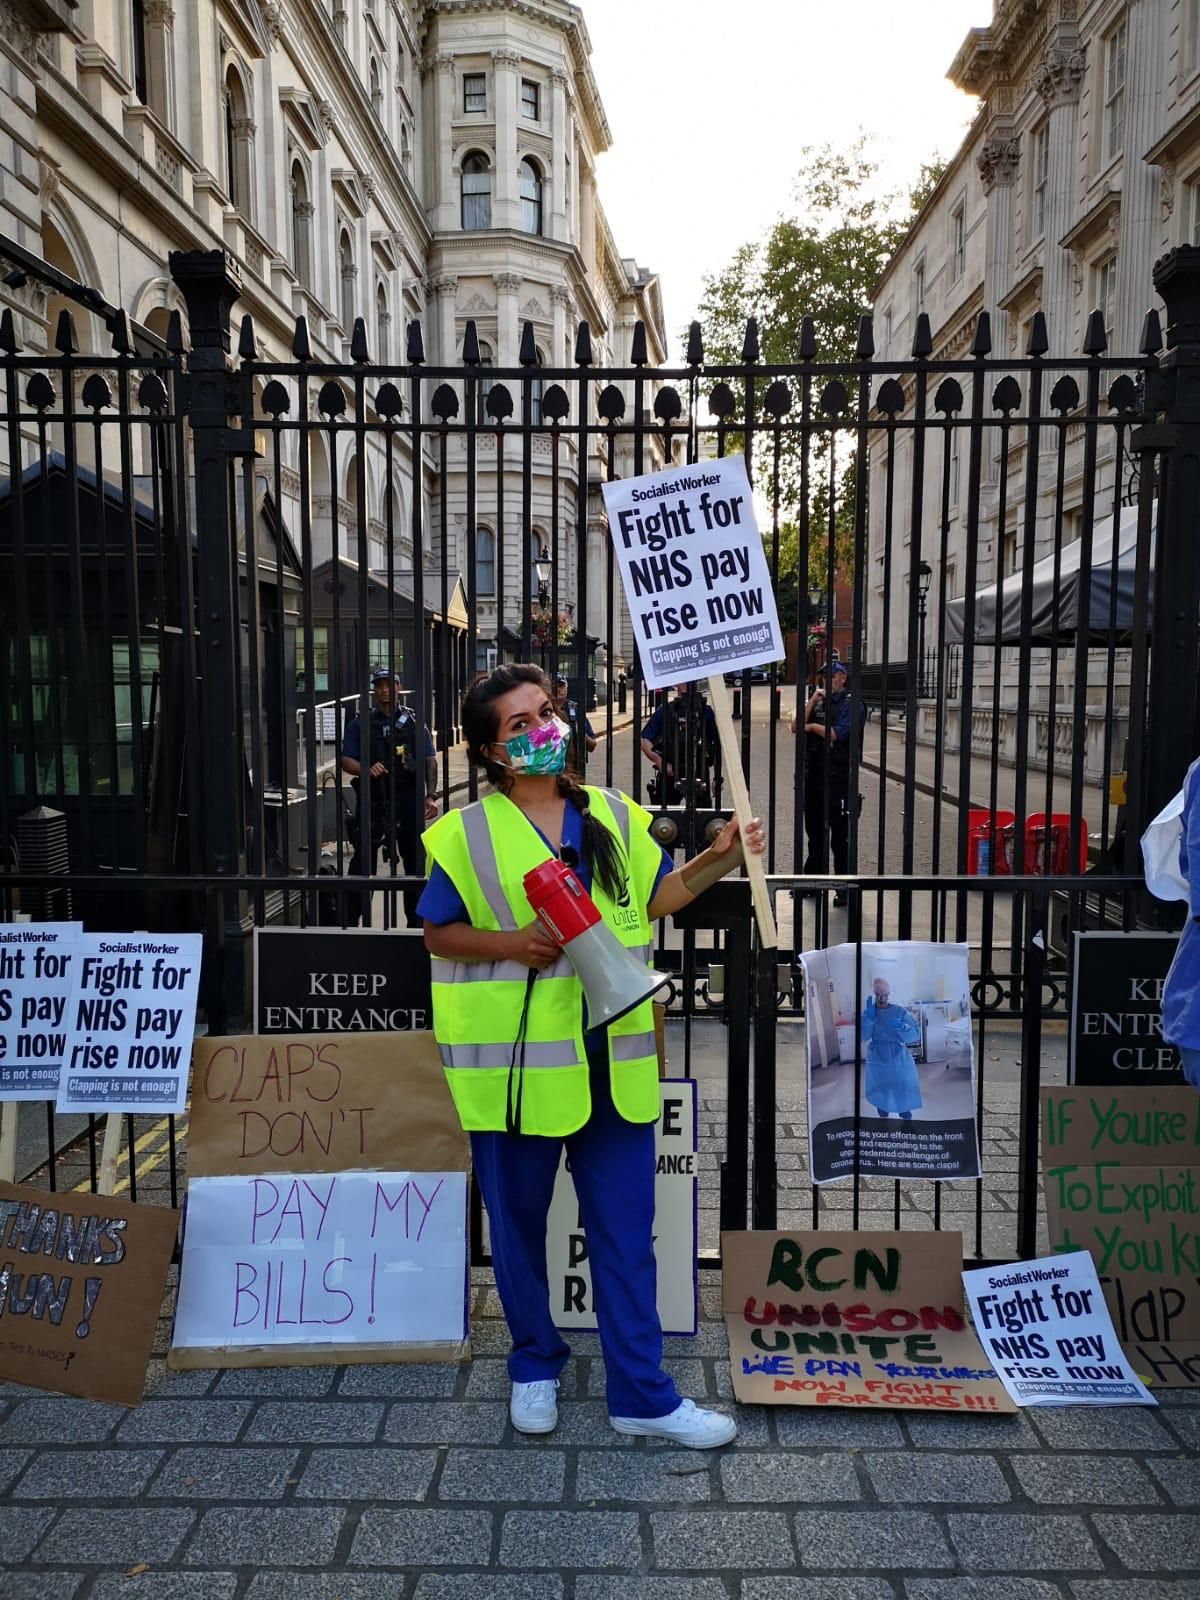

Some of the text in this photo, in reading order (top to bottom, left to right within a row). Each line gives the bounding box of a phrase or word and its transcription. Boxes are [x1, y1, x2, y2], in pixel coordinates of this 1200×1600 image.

[618, 492, 744, 552] Fight for
[628, 546, 750, 597] NHS pay
[640, 588, 764, 640] rise now
[652, 643, 699, 664] Clapping
[700, 640, 710, 653] is
[712, 634, 732, 650] not
[733, 625, 770, 646] enough
[612, 910, 638, 926] unite
[33, 947, 72, 978] for
[80, 957, 192, 996] Fight for
[308, 973, 387, 996] KEEP
[1128, 978, 1165, 1000] KE
[22, 996, 66, 1028] pay
[76, 999, 183, 1040] NHS pay
[264, 1006, 428, 1031] ENTRANCE
[1082, 1012, 1164, 1036] ENTR
[17, 1034, 66, 1058] now
[70, 1036, 182, 1070] rise now
[1112, 1048, 1183, 1070] CLE
[2, 1068, 61, 1080] is not enoug
[69, 1078, 109, 1094] Clapping
[111, 1080, 120, 1091] is
[122, 1080, 138, 1092] not
[142, 1080, 176, 1094] enough
[238, 1107, 374, 1158] DON'T
[826, 1133, 834, 1141] To
[836, 1130, 870, 1139] recogise
[872, 1131, 889, 1139] your
[890, 1130, 916, 1140] efforts
[1047, 1097, 1077, 1145] IF
[840, 1149, 896, 1158] unpcedented
[898, 1151, 940, 1161] challenges
[875, 1140, 918, 1151] responding
[830, 1160, 876, 1169] coronarus..
[937, 1161, 959, 1170] claps!
[1048, 1164, 1092, 1212] To
[248, 1176, 444, 1244] PAY MY
[1094, 1225, 1164, 1274] You
[767, 1238, 901, 1292] RCN
[744, 1296, 967, 1332] UNISON
[976, 1284, 1092, 1333] Fight for
[750, 1328, 942, 1364] UNITE
[989, 1333, 1106, 1363] NHS pay
[1003, 1362, 1124, 1380] rise now
[774, 1380, 965, 1396] NOW FIGHT
[816, 1392, 878, 1405] FOR
[1016, 1382, 1063, 1392] Clapping
[1076, 1384, 1095, 1392] not
[1096, 1384, 1136, 1394] enough
